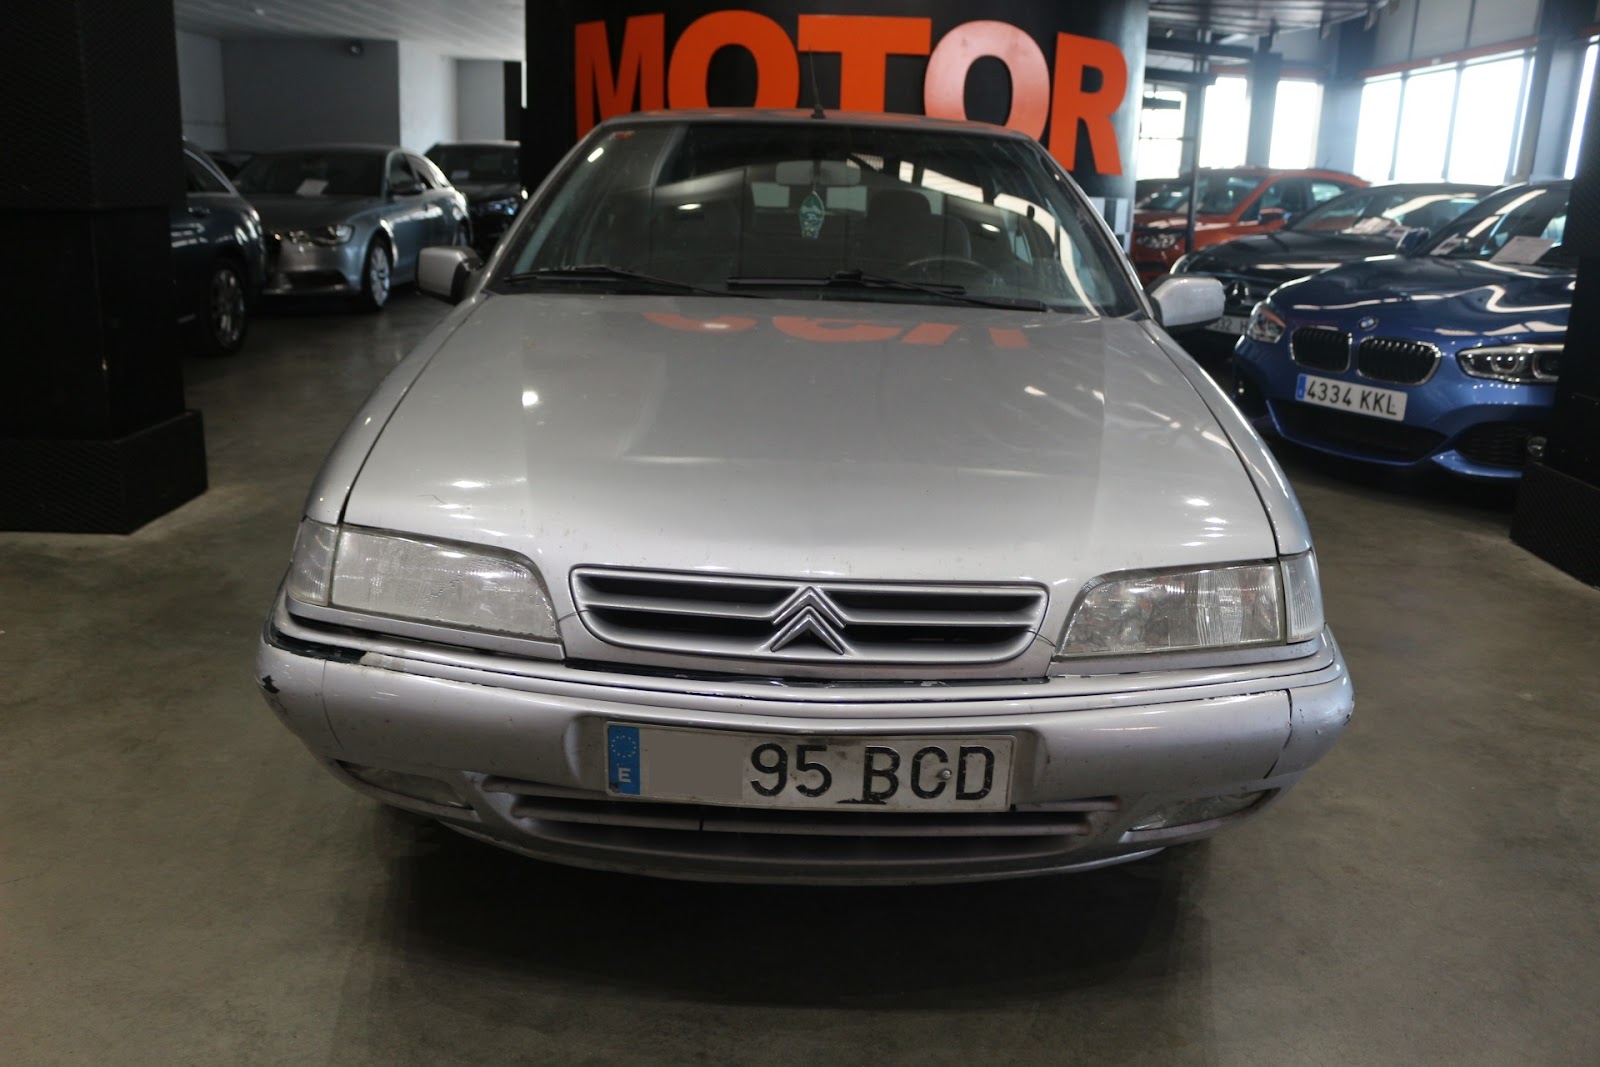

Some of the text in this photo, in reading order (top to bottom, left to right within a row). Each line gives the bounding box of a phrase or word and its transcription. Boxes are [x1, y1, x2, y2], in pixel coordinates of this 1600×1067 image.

[575, 10, 1128, 176] MOTOR
[1307, 380, 1397, 416] 4334 KKL
[618, 767, 631, 783] E
[863, 745, 995, 800] BCD
